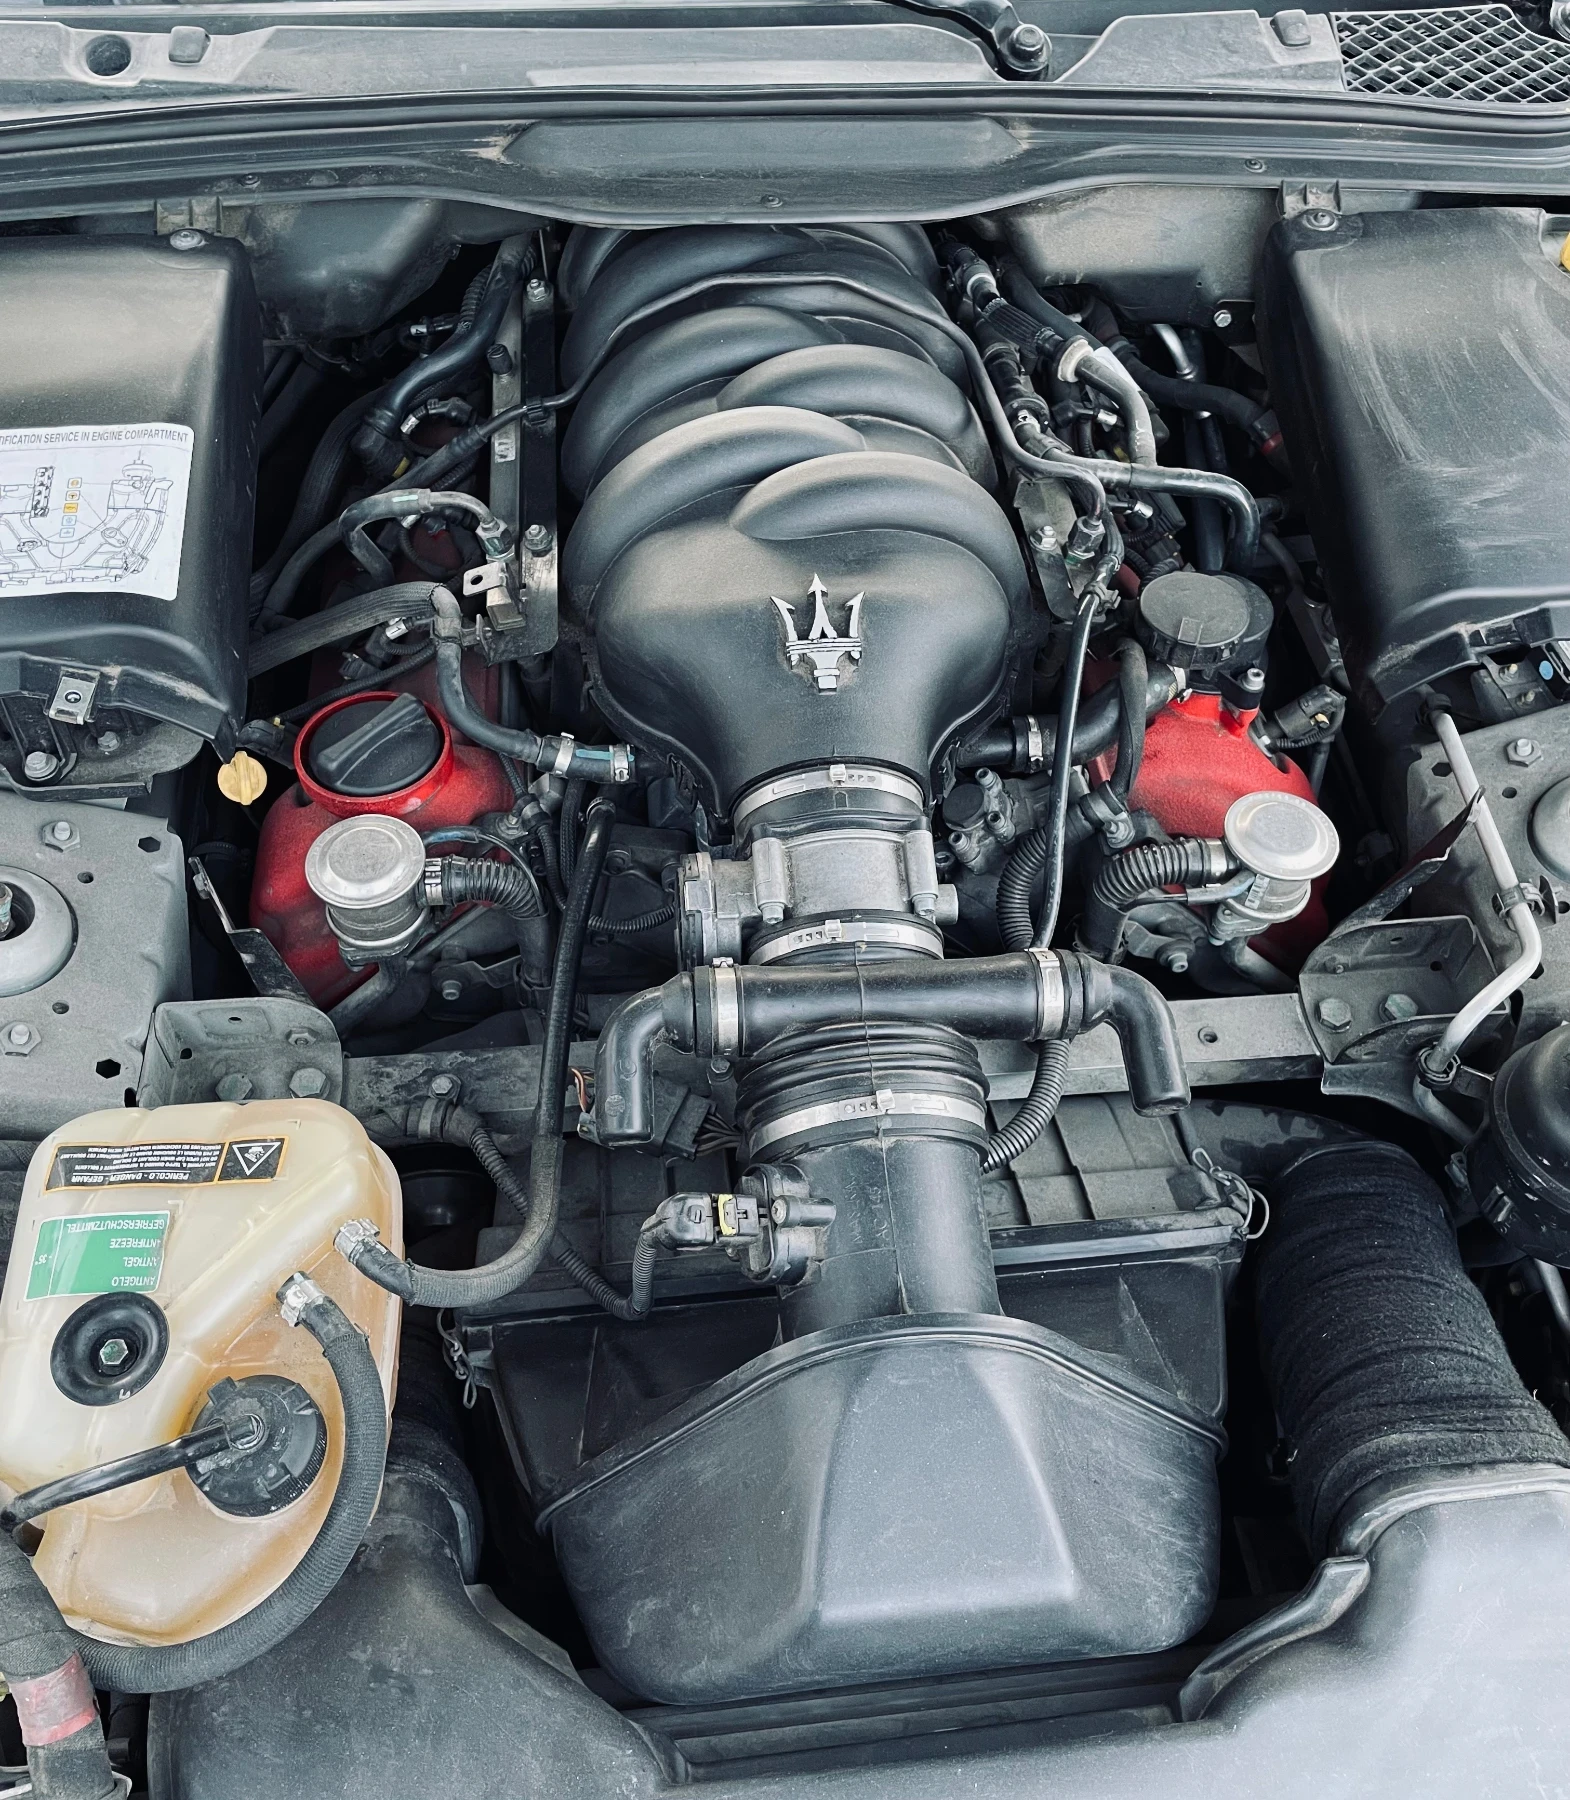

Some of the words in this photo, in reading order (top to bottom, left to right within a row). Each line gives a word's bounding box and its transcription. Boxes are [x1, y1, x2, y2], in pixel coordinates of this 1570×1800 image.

[44, 432, 79, 443] SERVICE
[81, 432, 90, 441] IN
[92, 431, 123, 441] ENGINE
[124, 429, 188, 442] COMPARTMENT
[110, 1173, 142, 1181] DANGER
[66, 1219, 165, 1233] GEFRIERSCHUTZMITTEL
[123, 1257, 160, 1267] ANTIGEL
[111, 1276, 156, 1287] ANTIGELO
